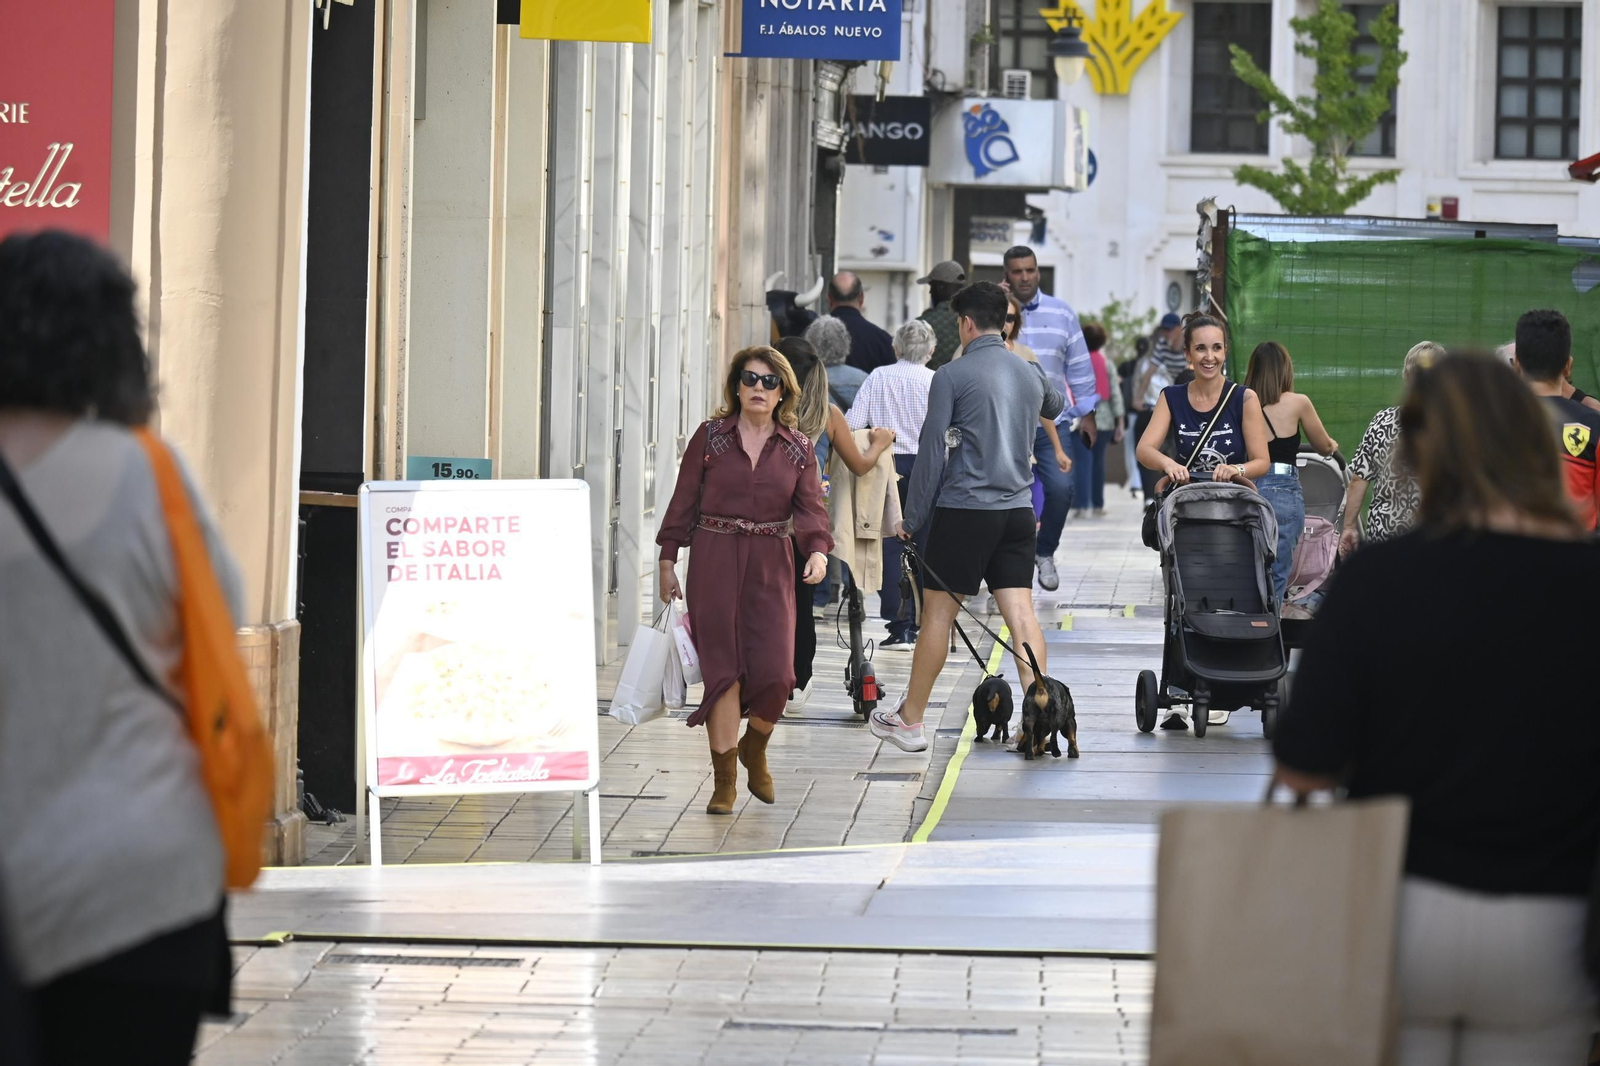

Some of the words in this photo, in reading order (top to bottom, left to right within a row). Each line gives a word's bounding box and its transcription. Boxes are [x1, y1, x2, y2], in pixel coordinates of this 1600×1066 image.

[778, 21, 827, 36] ÁBALOS
[834, 25, 882, 38] NUEVO
[385, 515, 521, 537] COMPARTE
[386, 540, 415, 560] EL
[422, 539, 506, 558] SABOR
[386, 563, 417, 583] DE
[425, 562, 503, 581] ITALIA
